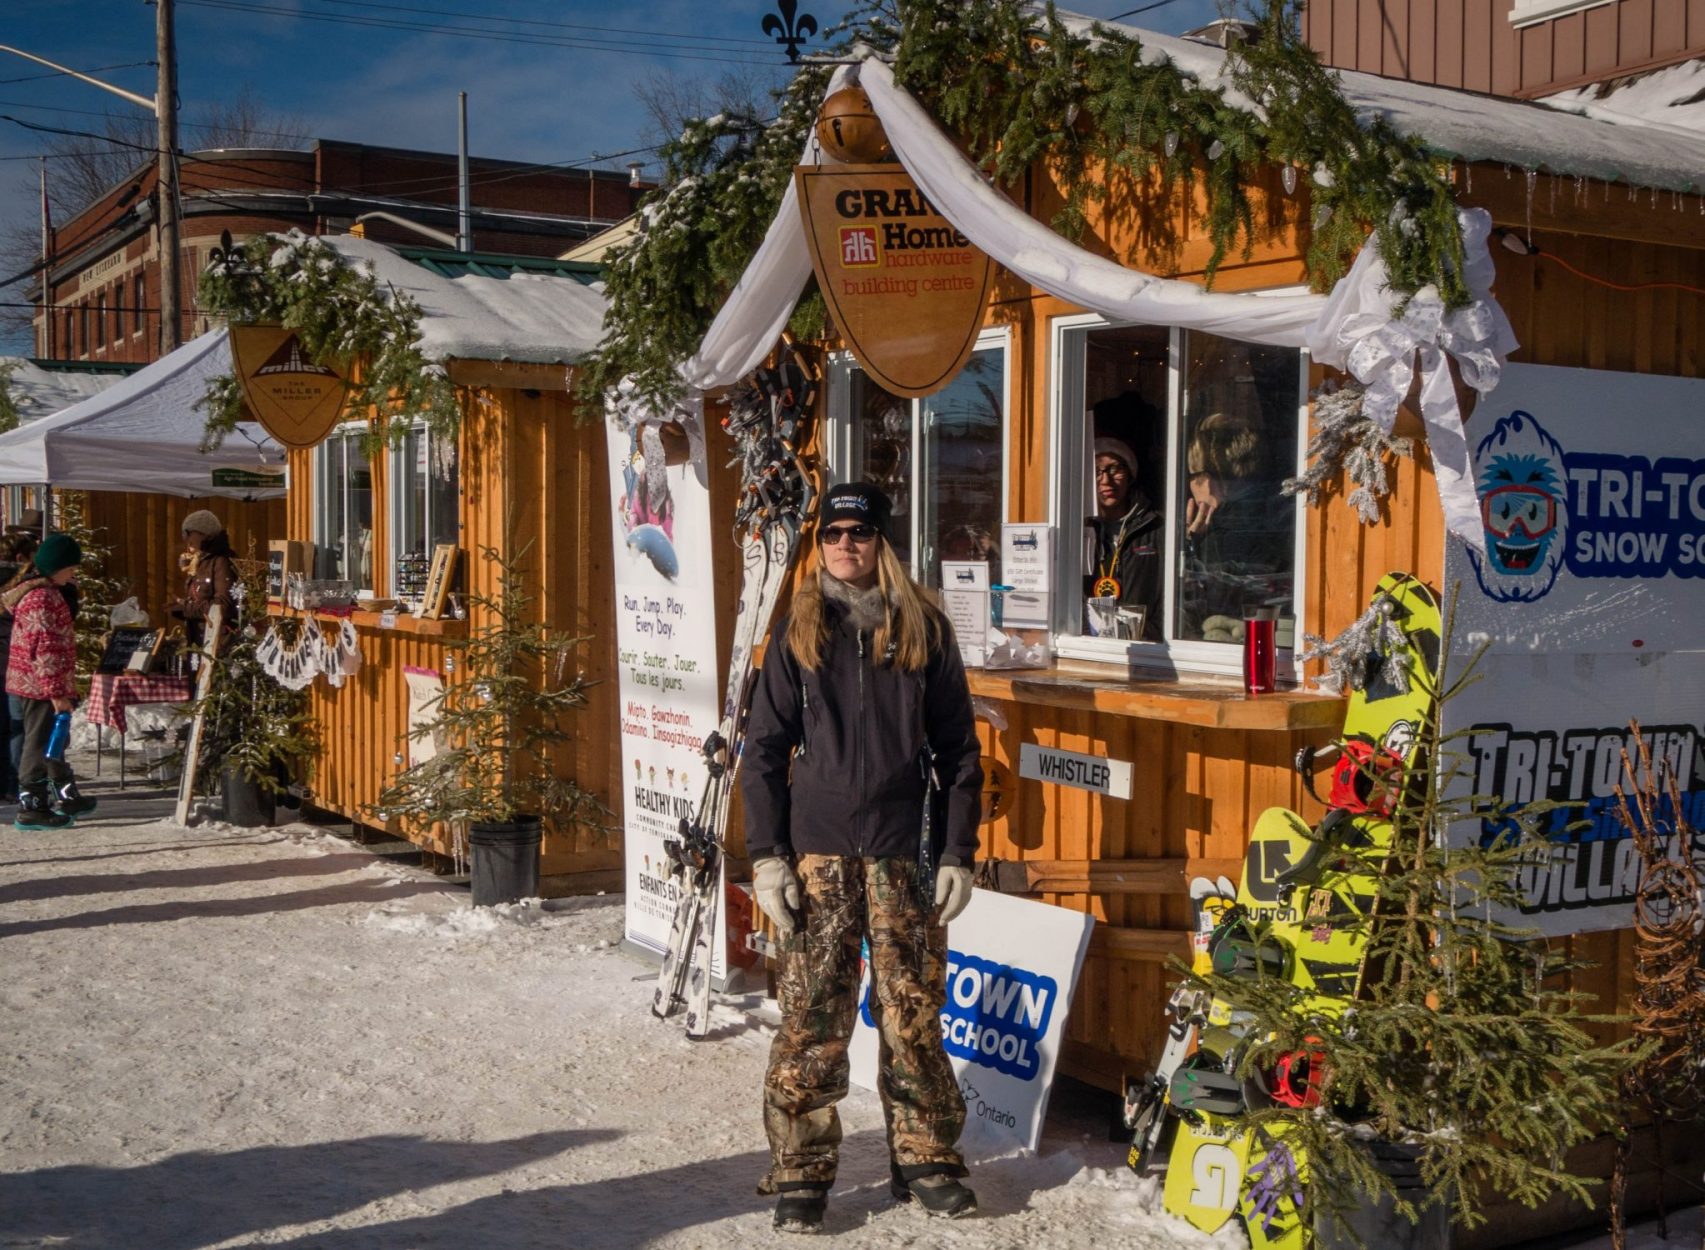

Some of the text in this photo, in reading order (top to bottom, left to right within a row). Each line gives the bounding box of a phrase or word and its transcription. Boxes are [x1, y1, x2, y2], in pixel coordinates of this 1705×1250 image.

[835, 188, 943, 219] GRAN
[881, 222, 970, 250] Home
[885, 250, 973, 269] hardware
[842, 275, 975, 298] building centre
[1575, 530, 1669, 564] SNOW
[624, 594, 687, 620] Run. Jump. Play.
[636, 615, 676, 640] Every Day.
[643, 651, 670, 670] Sauter.
[674, 654, 701, 674] Jouer.
[630, 667, 686, 693] Tous les jours.
[1038, 753, 1111, 789] WHISTLER
[634, 786, 695, 823] HEALTHY KIDS
[636, 813, 665, 830] COMMUNITY
[1519, 831, 1692, 908] VILLA
[639, 872, 678, 903] ENFANTS EN
[940, 1013, 1031, 1069] SCHOOL
[976, 1100, 1016, 1129] Ontario
